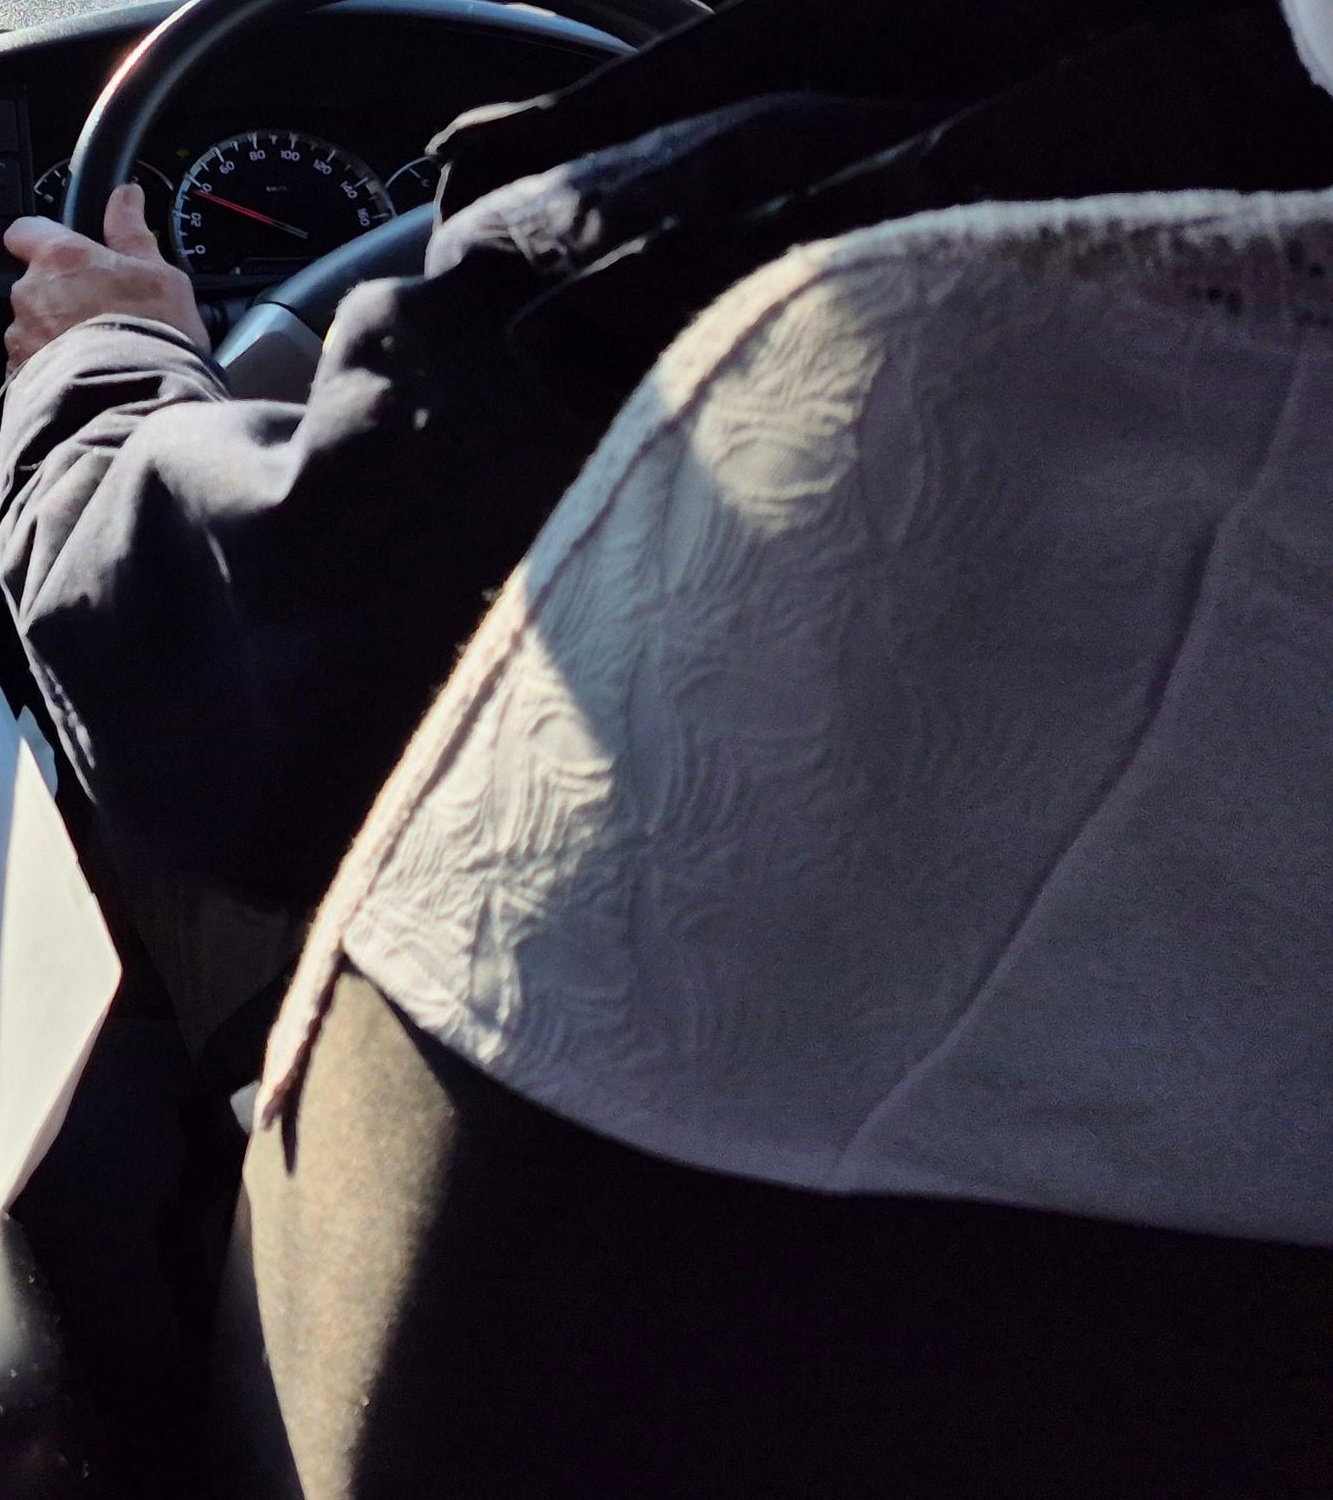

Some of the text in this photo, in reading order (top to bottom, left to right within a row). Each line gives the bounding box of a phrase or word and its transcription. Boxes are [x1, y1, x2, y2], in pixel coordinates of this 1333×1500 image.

[249, 150, 266, 161] 80
[280, 150, 300, 161] 100
[219, 160, 235, 175] 60
[313, 158, 332, 175] 120
[190, 211, 202, 228] 20
[356, 207, 370, 227] 160
[195, 244, 206, 255] 0
